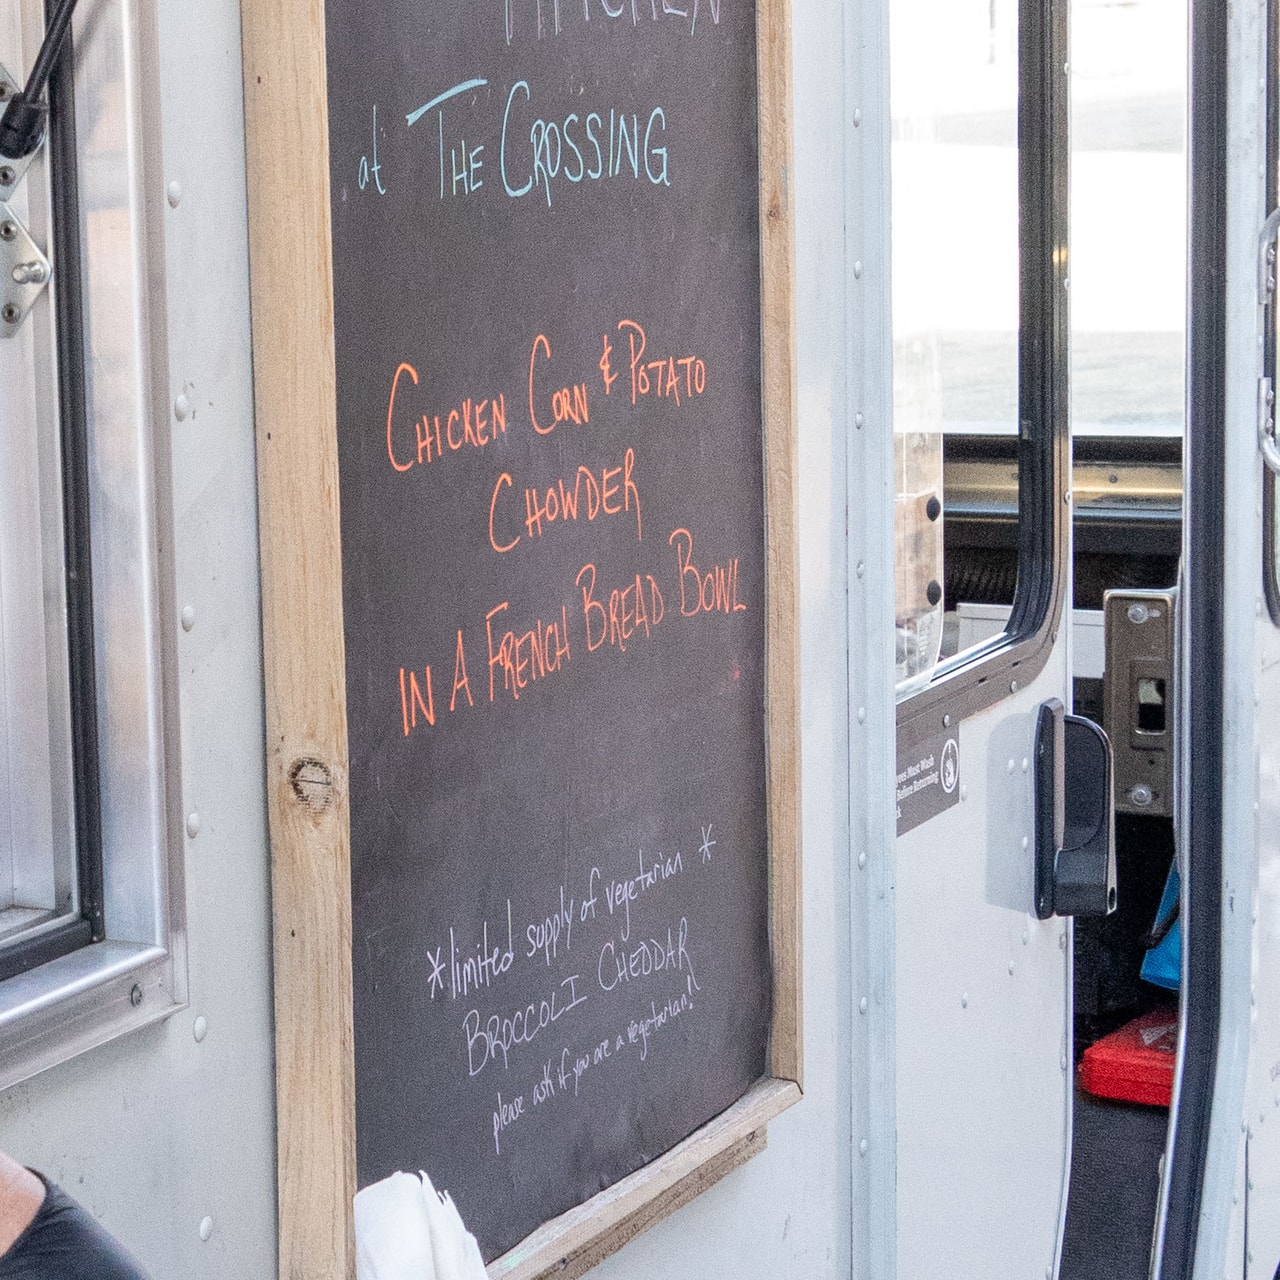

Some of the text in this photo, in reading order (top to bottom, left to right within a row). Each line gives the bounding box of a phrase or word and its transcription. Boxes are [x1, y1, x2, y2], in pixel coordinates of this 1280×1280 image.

[358, 104, 386, 195] at
[500, 80, 671, 207] CROSSING
[387, 363, 506, 471] CHICKEN
[529, 334, 589, 434] CORN
[617, 320, 706, 407] POTATO
[489, 448, 642, 553] CHOWDER
[399, 528, 747, 736] IN A FRENCH BREAD BOWL
[527, 885, 574, 966] supply
[581, 867, 601, 921] of
[606, 849, 683, 942] vegetarian
[462, 917, 701, 1076] BROCCOLI CHEDDAR
[493, 1092, 525, 1155] please
[533, 1059, 555, 1105] ask
[558, 1048, 571, 1090] if
[573, 1054, 589, 1097] you
[594, 1039, 611, 1065] are
[616, 1035, 624, 1051] a
